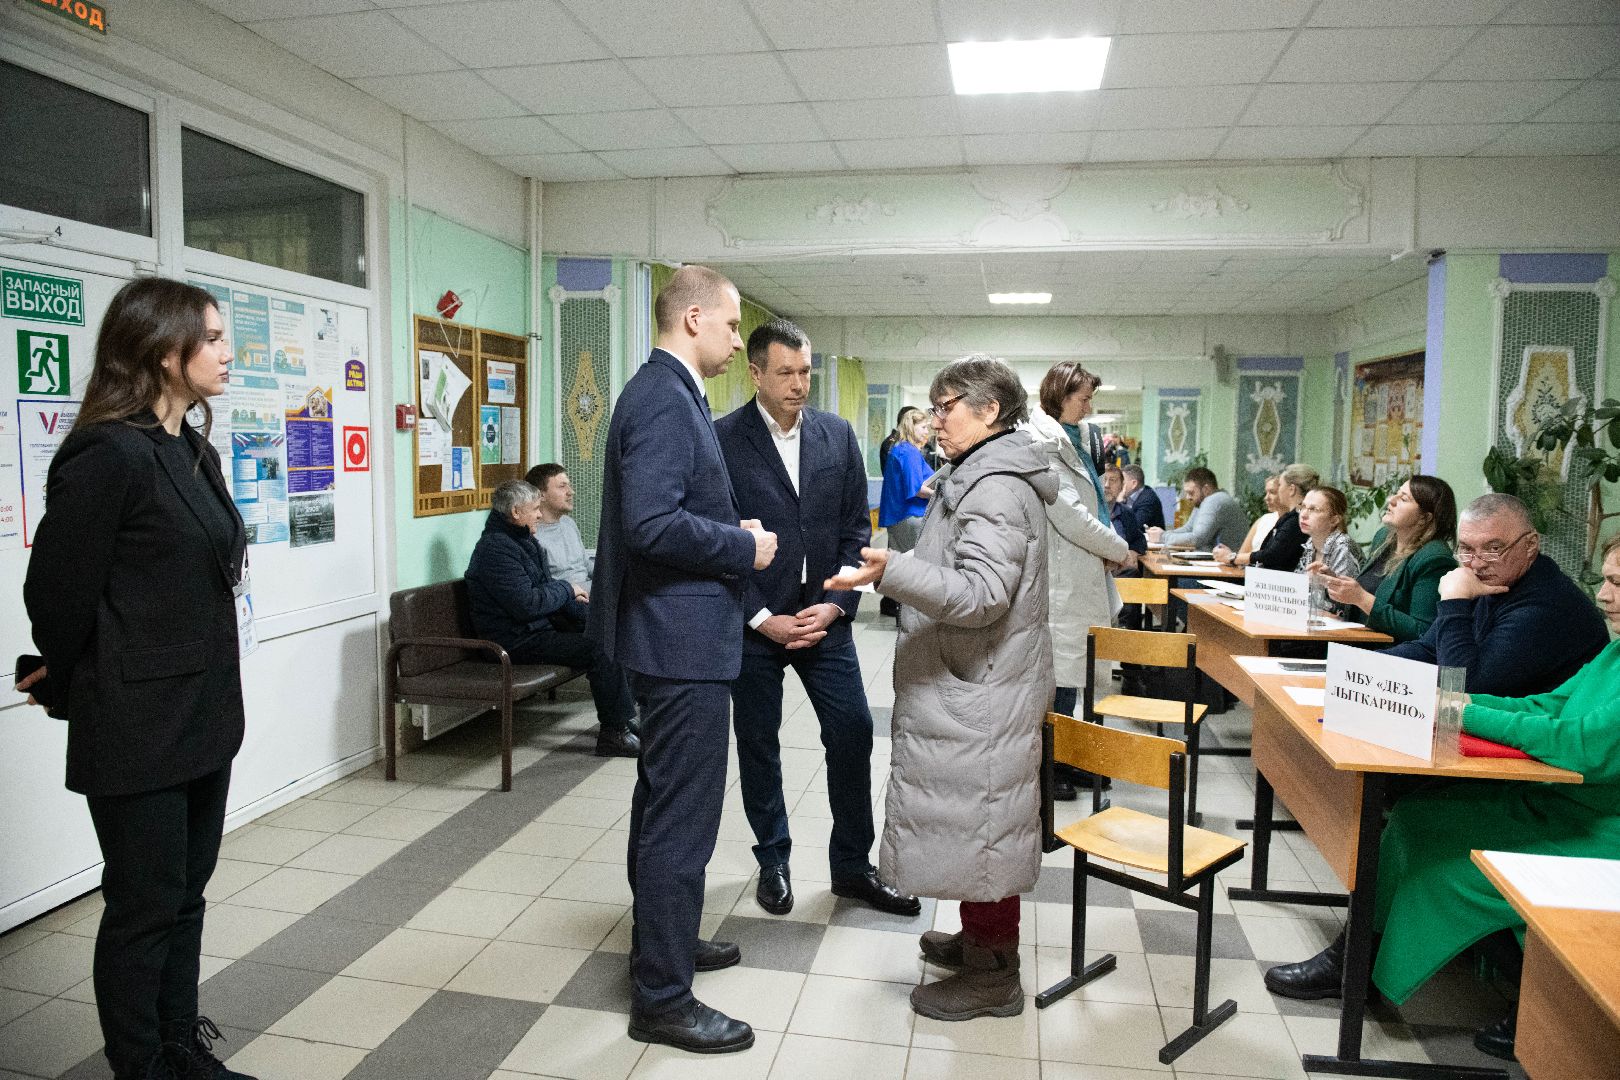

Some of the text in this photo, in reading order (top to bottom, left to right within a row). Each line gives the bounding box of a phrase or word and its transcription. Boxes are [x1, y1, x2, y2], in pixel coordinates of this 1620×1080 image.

[5, 276, 80, 299] ЗАПАСНЫЙ
[6, 290, 81, 321] ВЫХОД
[1244, 590, 1308, 607] КОММУНАЛЬНОЕ
[1253, 601, 1297, 615] ХОЗЯЙСТВО
[1345, 670, 1414, 696] МБУ «ДЕЗ-
[1331, 685, 1426, 720] ЛЫТКАРИНО»
